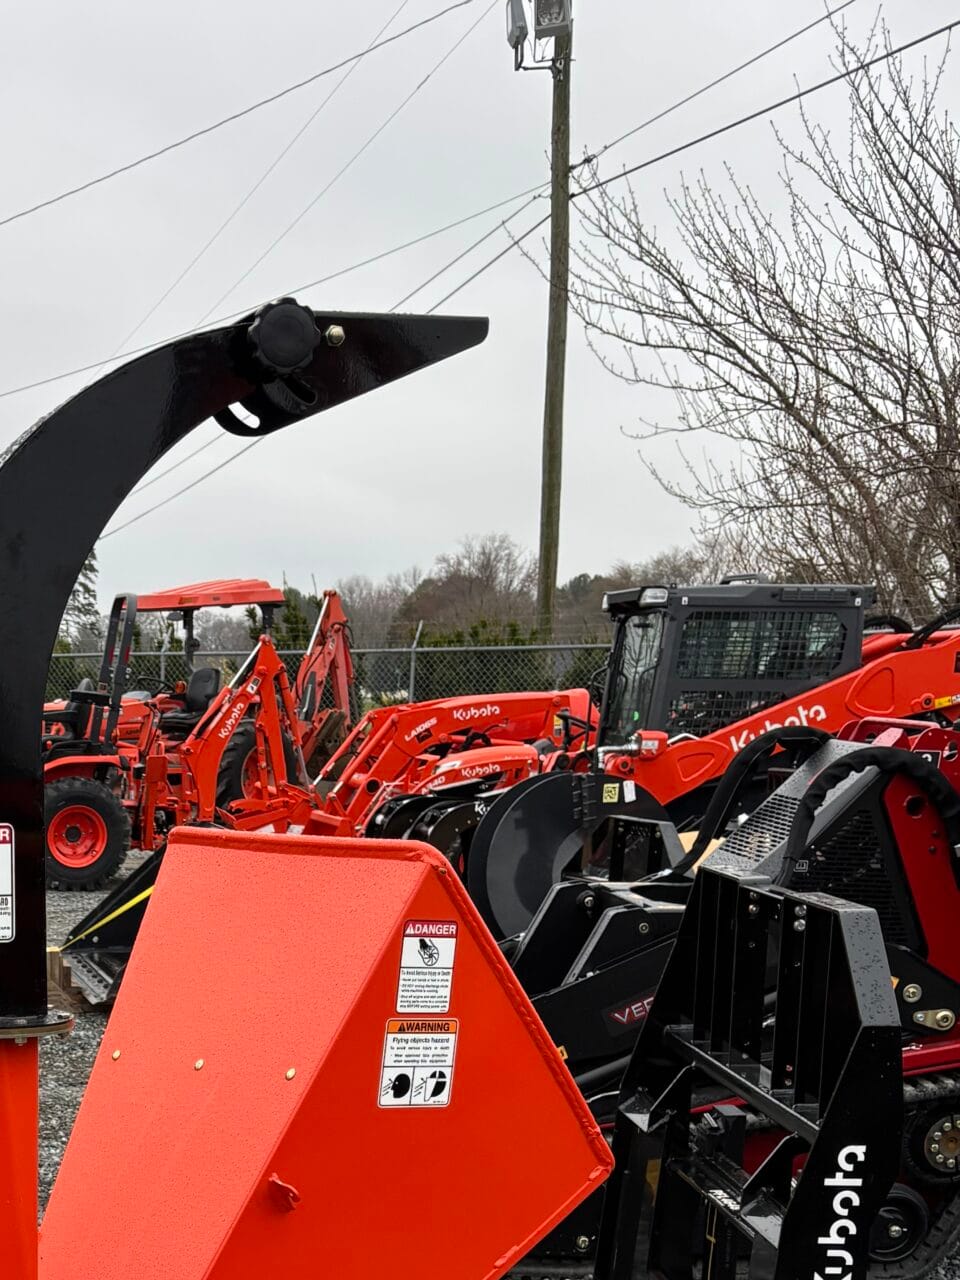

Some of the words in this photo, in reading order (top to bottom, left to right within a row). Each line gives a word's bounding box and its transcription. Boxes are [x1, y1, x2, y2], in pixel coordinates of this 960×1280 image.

[453, 703, 501, 720] Kubota
[218, 702, 245, 739] Kubota
[461, 763, 501, 777] Kubota
[414, 924, 457, 935] DANGER
[405, 1022, 450, 1032] WARNING
